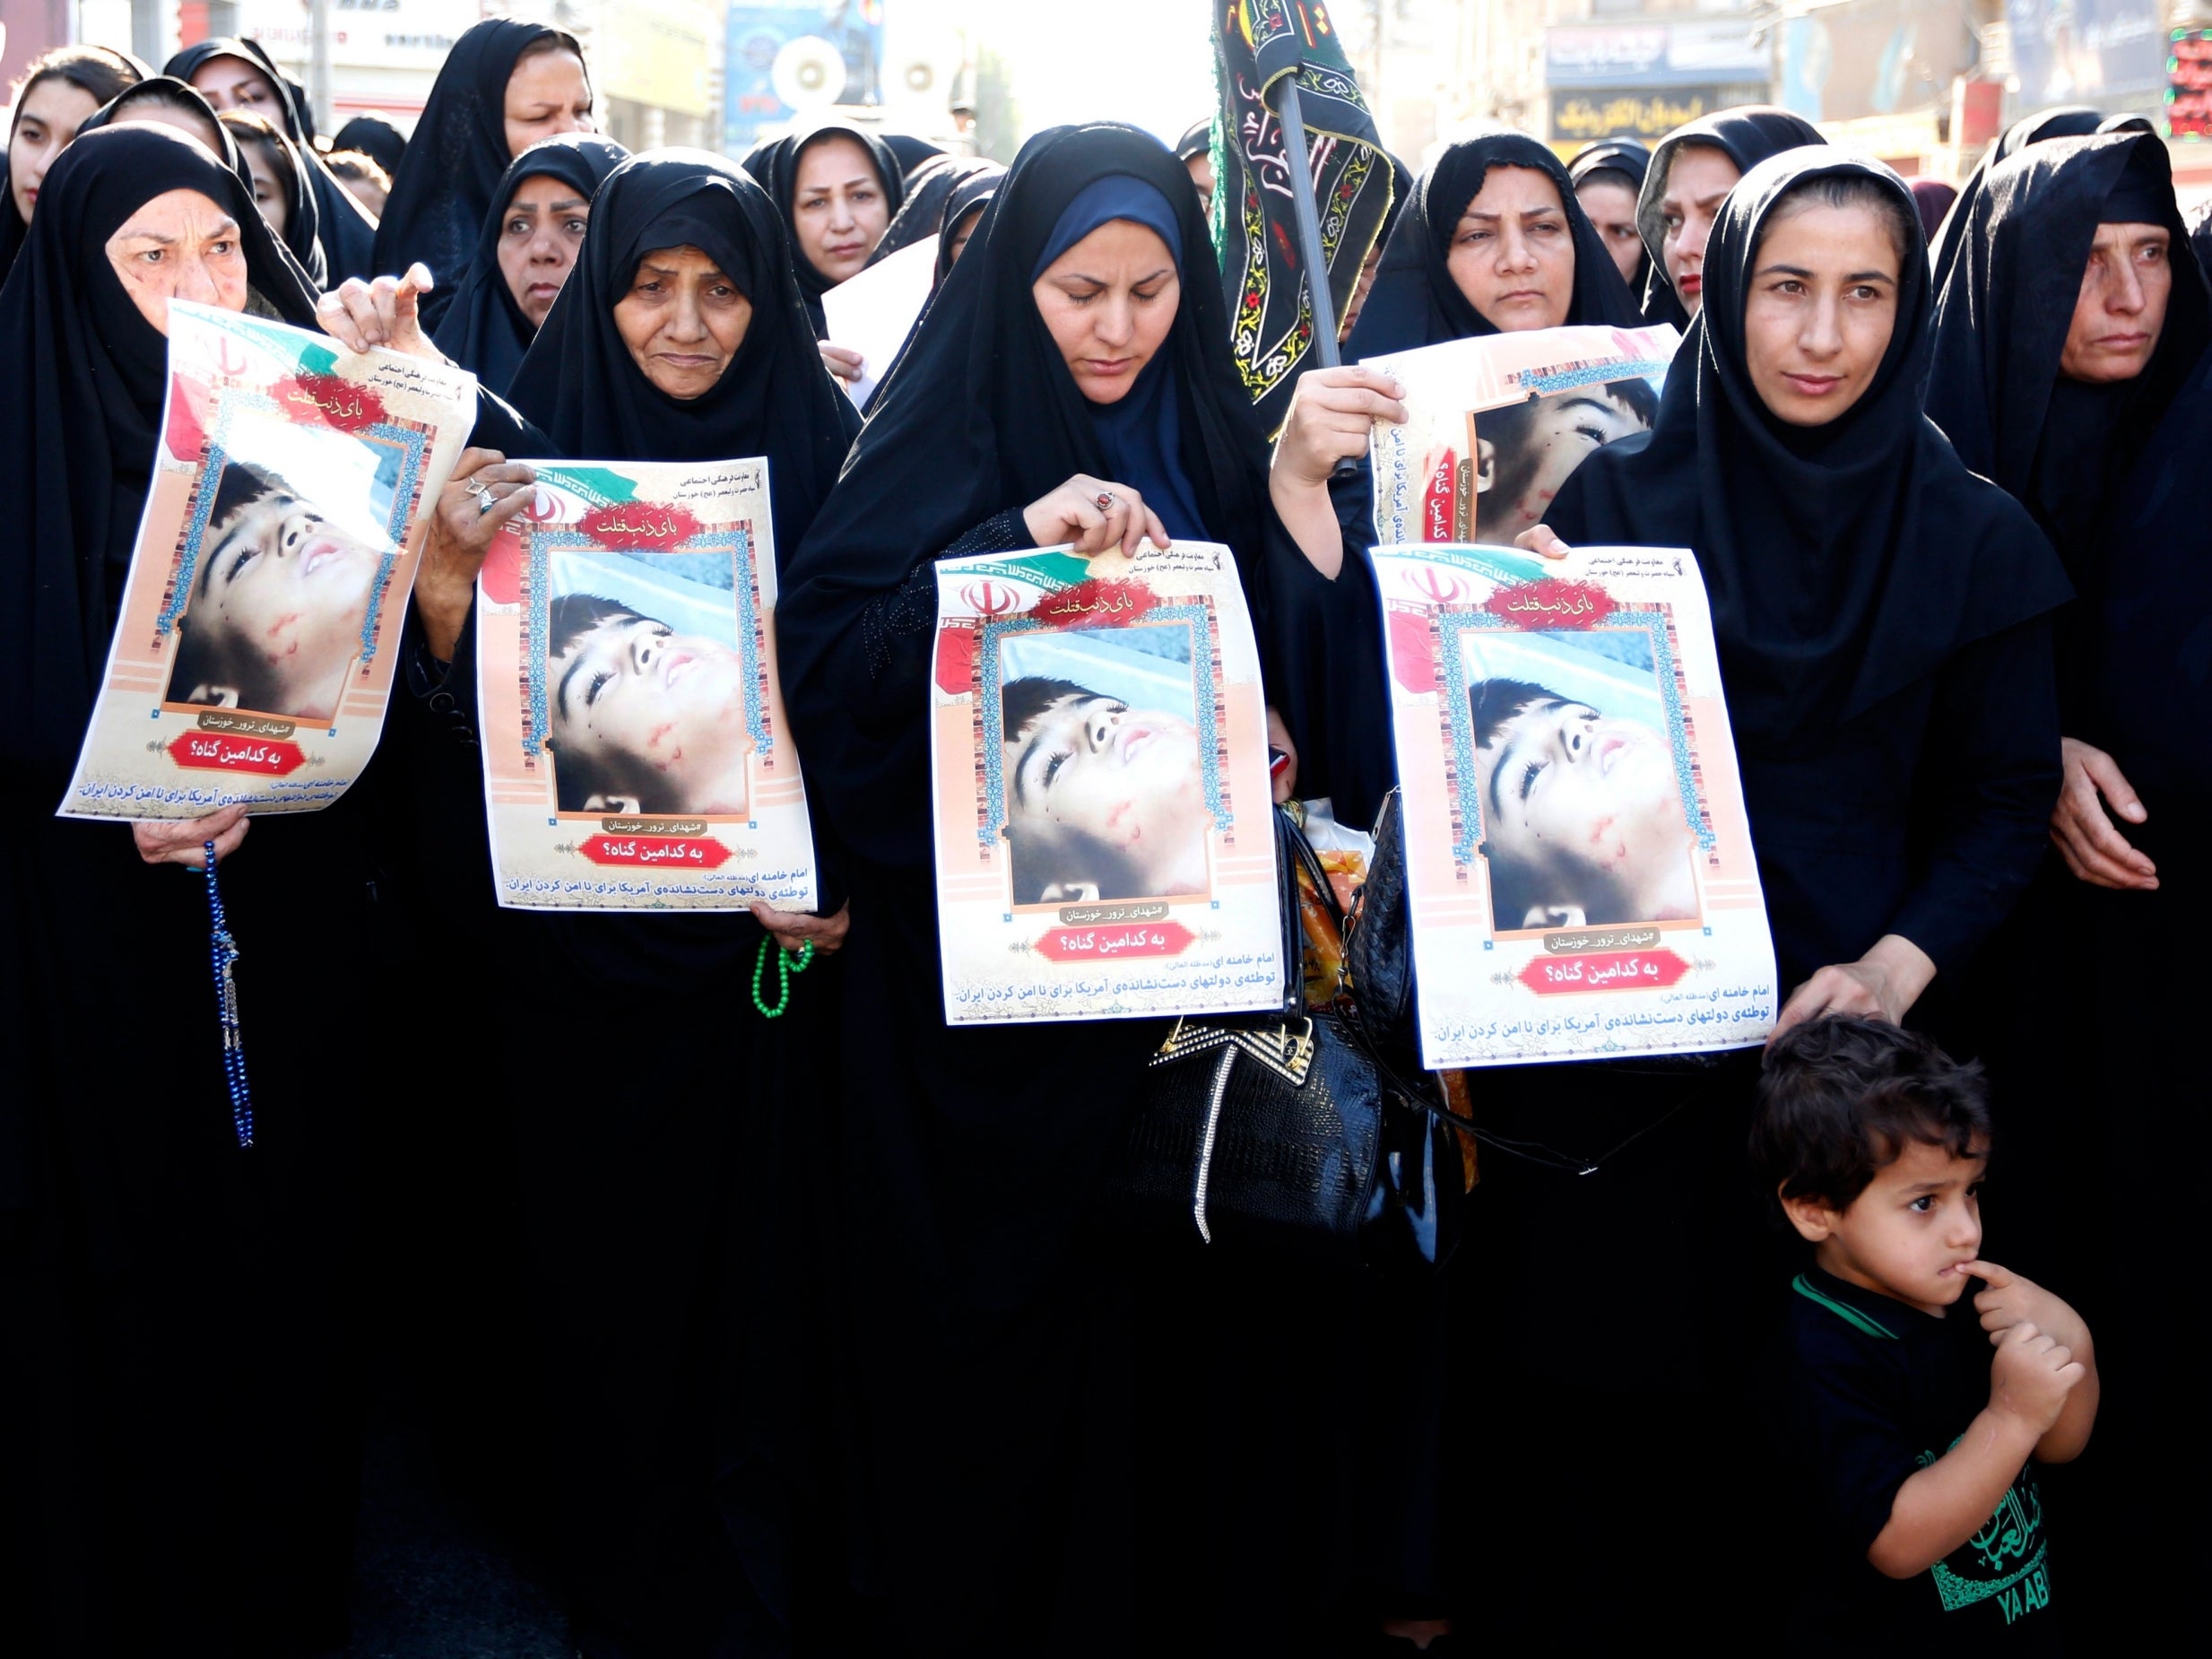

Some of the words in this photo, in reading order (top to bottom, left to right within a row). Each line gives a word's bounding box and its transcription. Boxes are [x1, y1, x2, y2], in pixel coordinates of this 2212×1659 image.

[1394, 460, 1406, 481] برای
[1435, 462, 1450, 494] گناه؟
[1393, 482, 1409, 511] آمریکا
[1429, 499, 1447, 538] کدامین
[190, 740, 221, 757] گناه؟
[220, 746, 267, 764] کدامین
[268, 751, 282, 769] به
[78, 783, 108, 798] ایران.
[108, 785, 135, 799] کردن
[164, 790, 187, 803] برای
[188, 789, 218, 805] آمریکا
[603, 841, 636, 856] گناه؟
[639, 843, 686, 861] کدامین
[689, 847, 703, 863] به
[761, 871, 787, 881] خامنه
[790, 868, 808, 882] امام
[506, 879, 533, 890] ایران.
[535, 880, 560, 892] کردن
[594, 882, 616, 895] برای
[619, 882, 650, 895] آمریکا
[727, 886, 766, 897] دولتهای
[1060, 932, 1096, 951] گناه؟
[1099, 930, 1147, 952] کدامین
[1150, 934, 1165, 950] به
[1226, 954, 1253, 965] خامنه
[1256, 952, 1275, 968] امام
[1545, 960, 1583, 982] گناه؟
[1588, 958, 1639, 984] کدامین
[1643, 962, 1659, 980] به
[1075, 978, 1108, 996] آمریکا
[1190, 975, 1231, 989] دولتهای
[956, 987, 984, 1003] ایران.
[987, 986, 1014, 1001] کردن
[1050, 984, 1072, 998] برای
[1722, 986, 1748, 998] خامنه
[1752, 985, 1769, 1002] امام
[1564, 1012, 1600, 1033] آمریکا
[1687, 1008, 1729, 1025] دولتهای
[1435, 1025, 1464, 1041] ایران.
[1469, 1021, 1497, 1039] کردن
[1536, 1019, 1561, 1036] برای
[1996, 1586, 2024, 1626] YA
